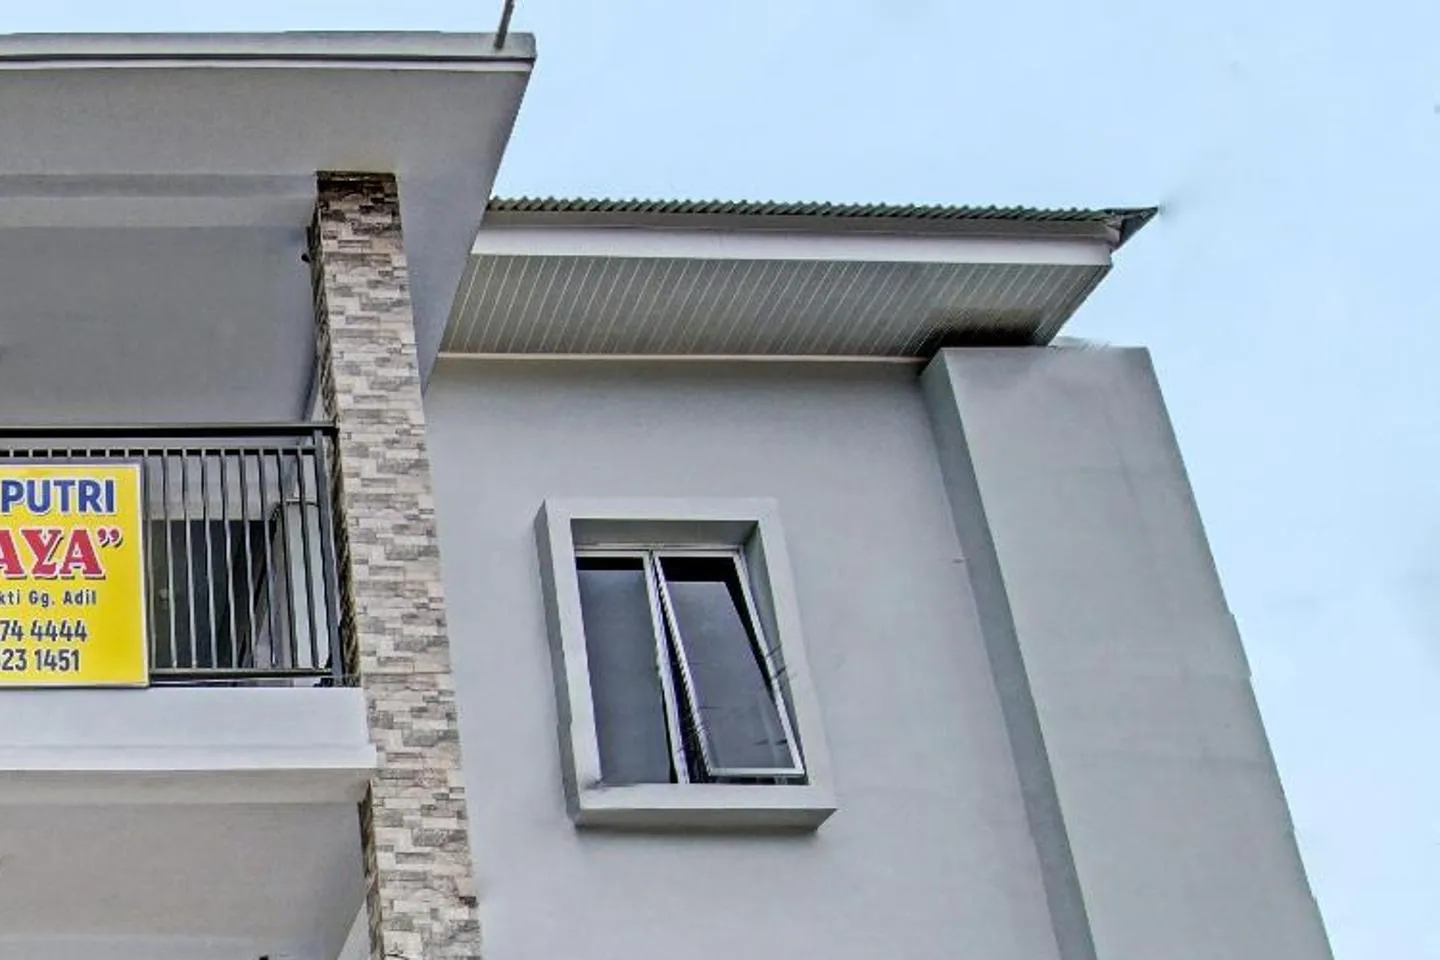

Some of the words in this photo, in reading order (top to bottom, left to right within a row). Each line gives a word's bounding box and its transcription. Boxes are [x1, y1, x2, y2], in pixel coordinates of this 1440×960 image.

[0, 479, 115, 514] PUTRI
[29, 590, 55, 608] Gg.
[63, 589, 97, 606] Adil
[31, 620, 88, 642] 4444
[34, 648, 80, 671] 1451
